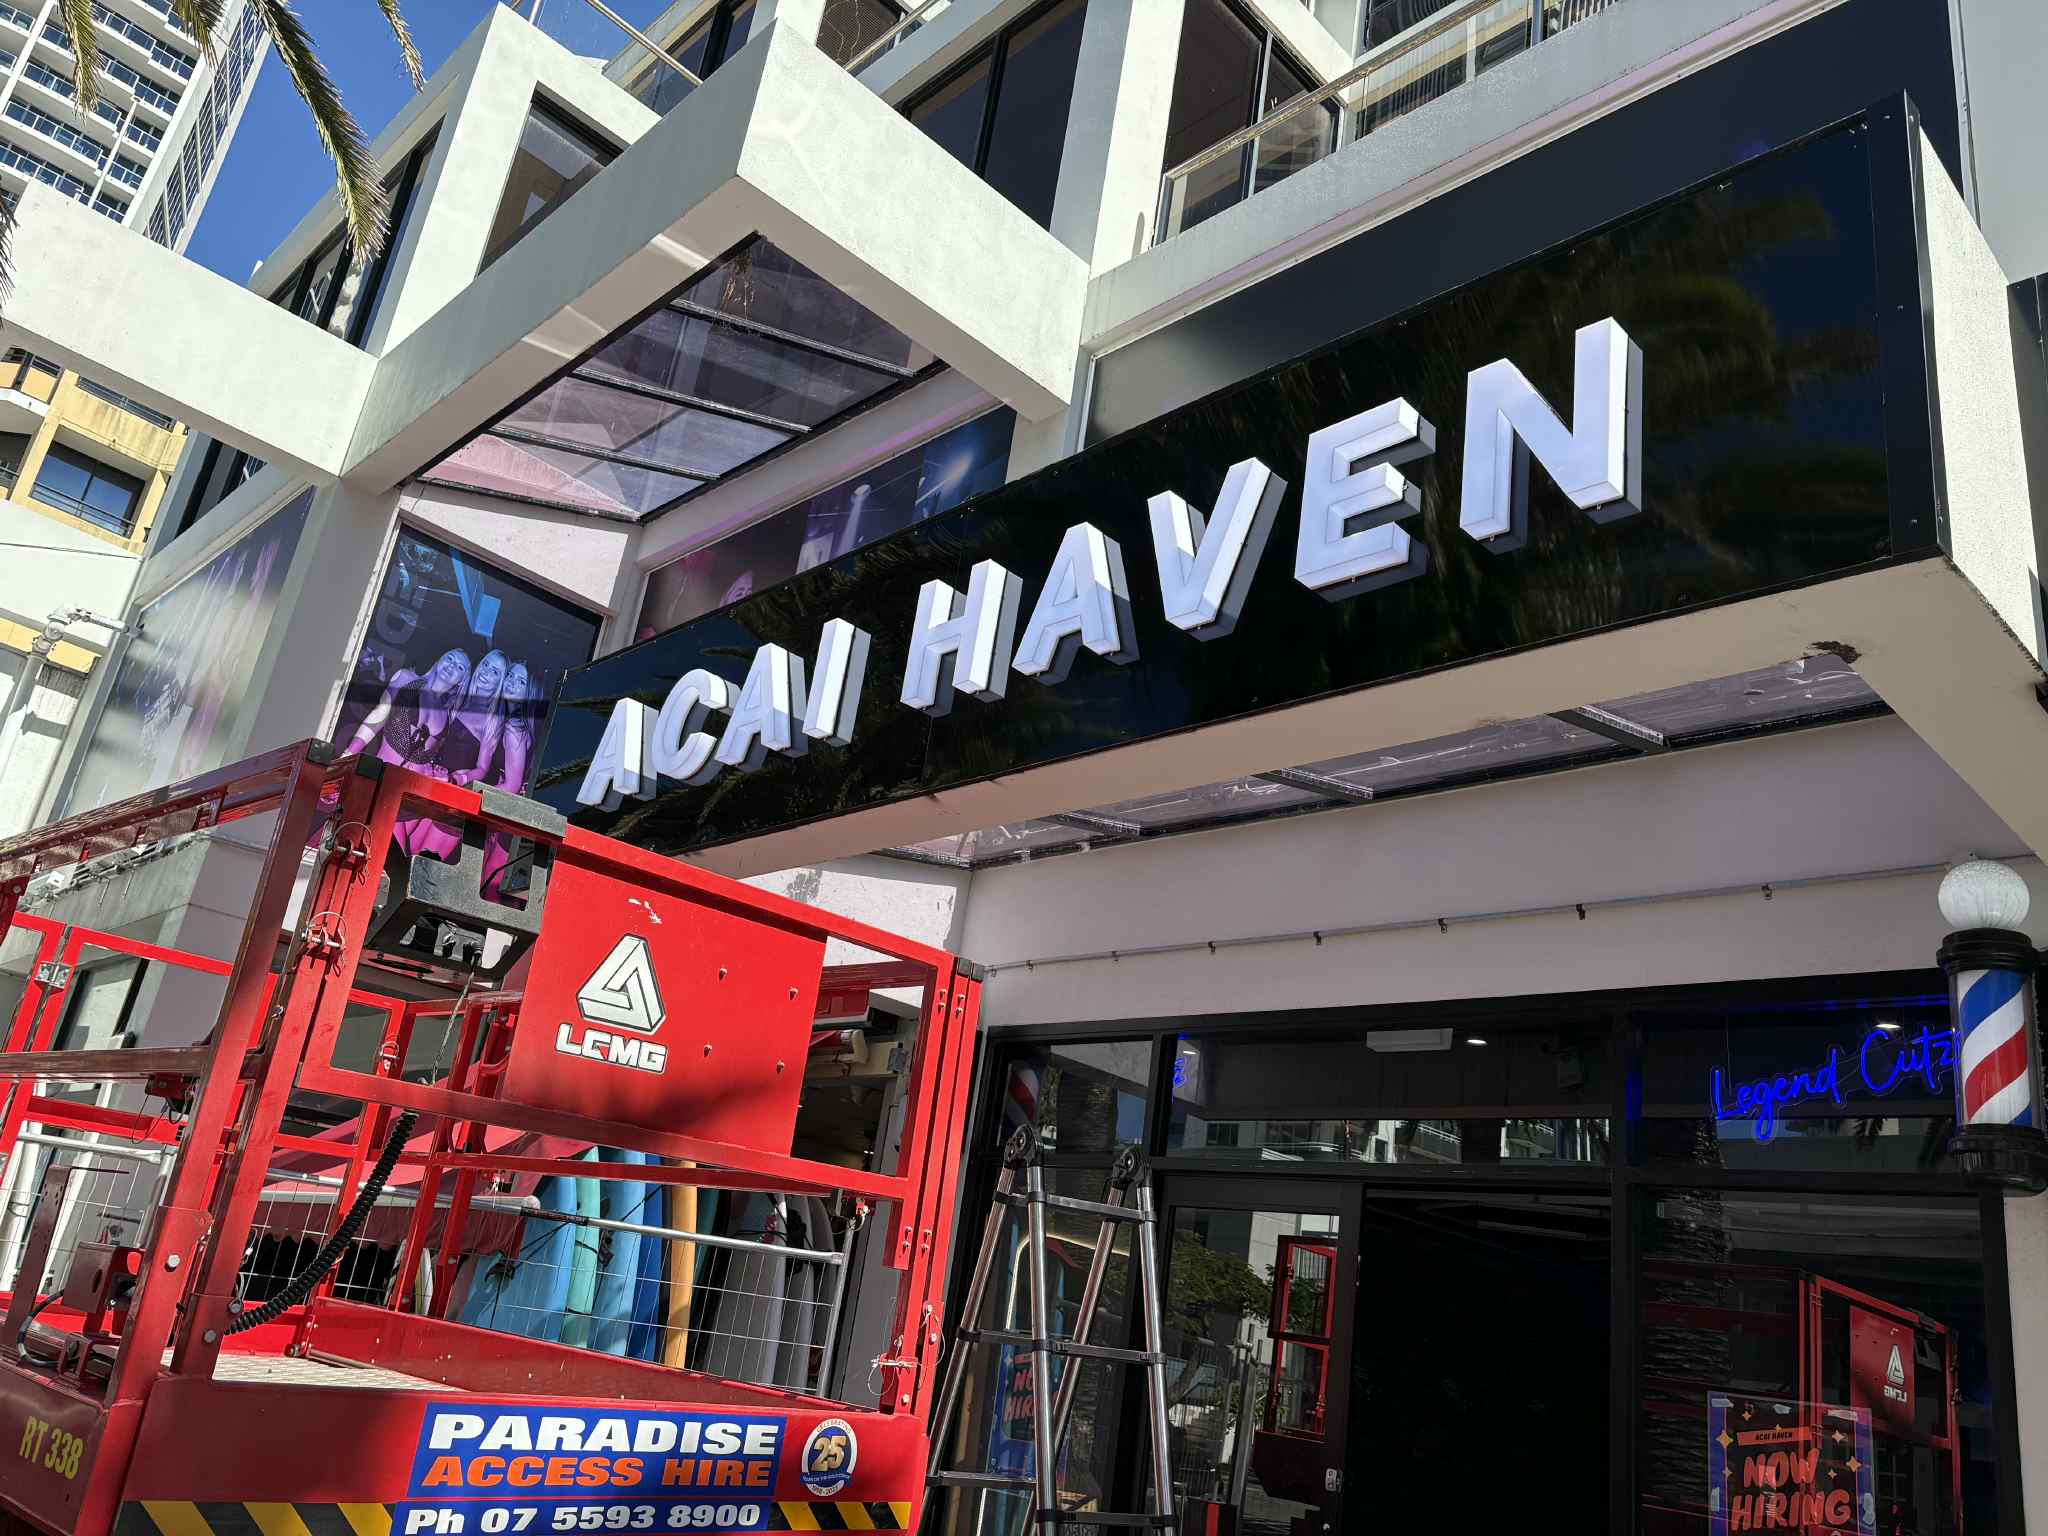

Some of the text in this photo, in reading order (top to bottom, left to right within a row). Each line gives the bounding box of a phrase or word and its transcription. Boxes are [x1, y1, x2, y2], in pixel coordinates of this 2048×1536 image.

[576, 316, 1634, 806] ACAI HAVEN
[554, 1022, 668, 1075] LGMG
[1714, 1047, 1842, 1141] Legend
[19, 1415, 84, 1479] RT 338
[428, 1413, 780, 1456] PARADISE
[811, 1435, 848, 1472] 25
[421, 1455, 772, 1487] ACCESS HIRE
[1743, 1447, 1820, 1488] NOW
[404, 1503, 761, 1535] Ph 07 5593 8900
[1730, 1488, 1851, 1531] HIRING
